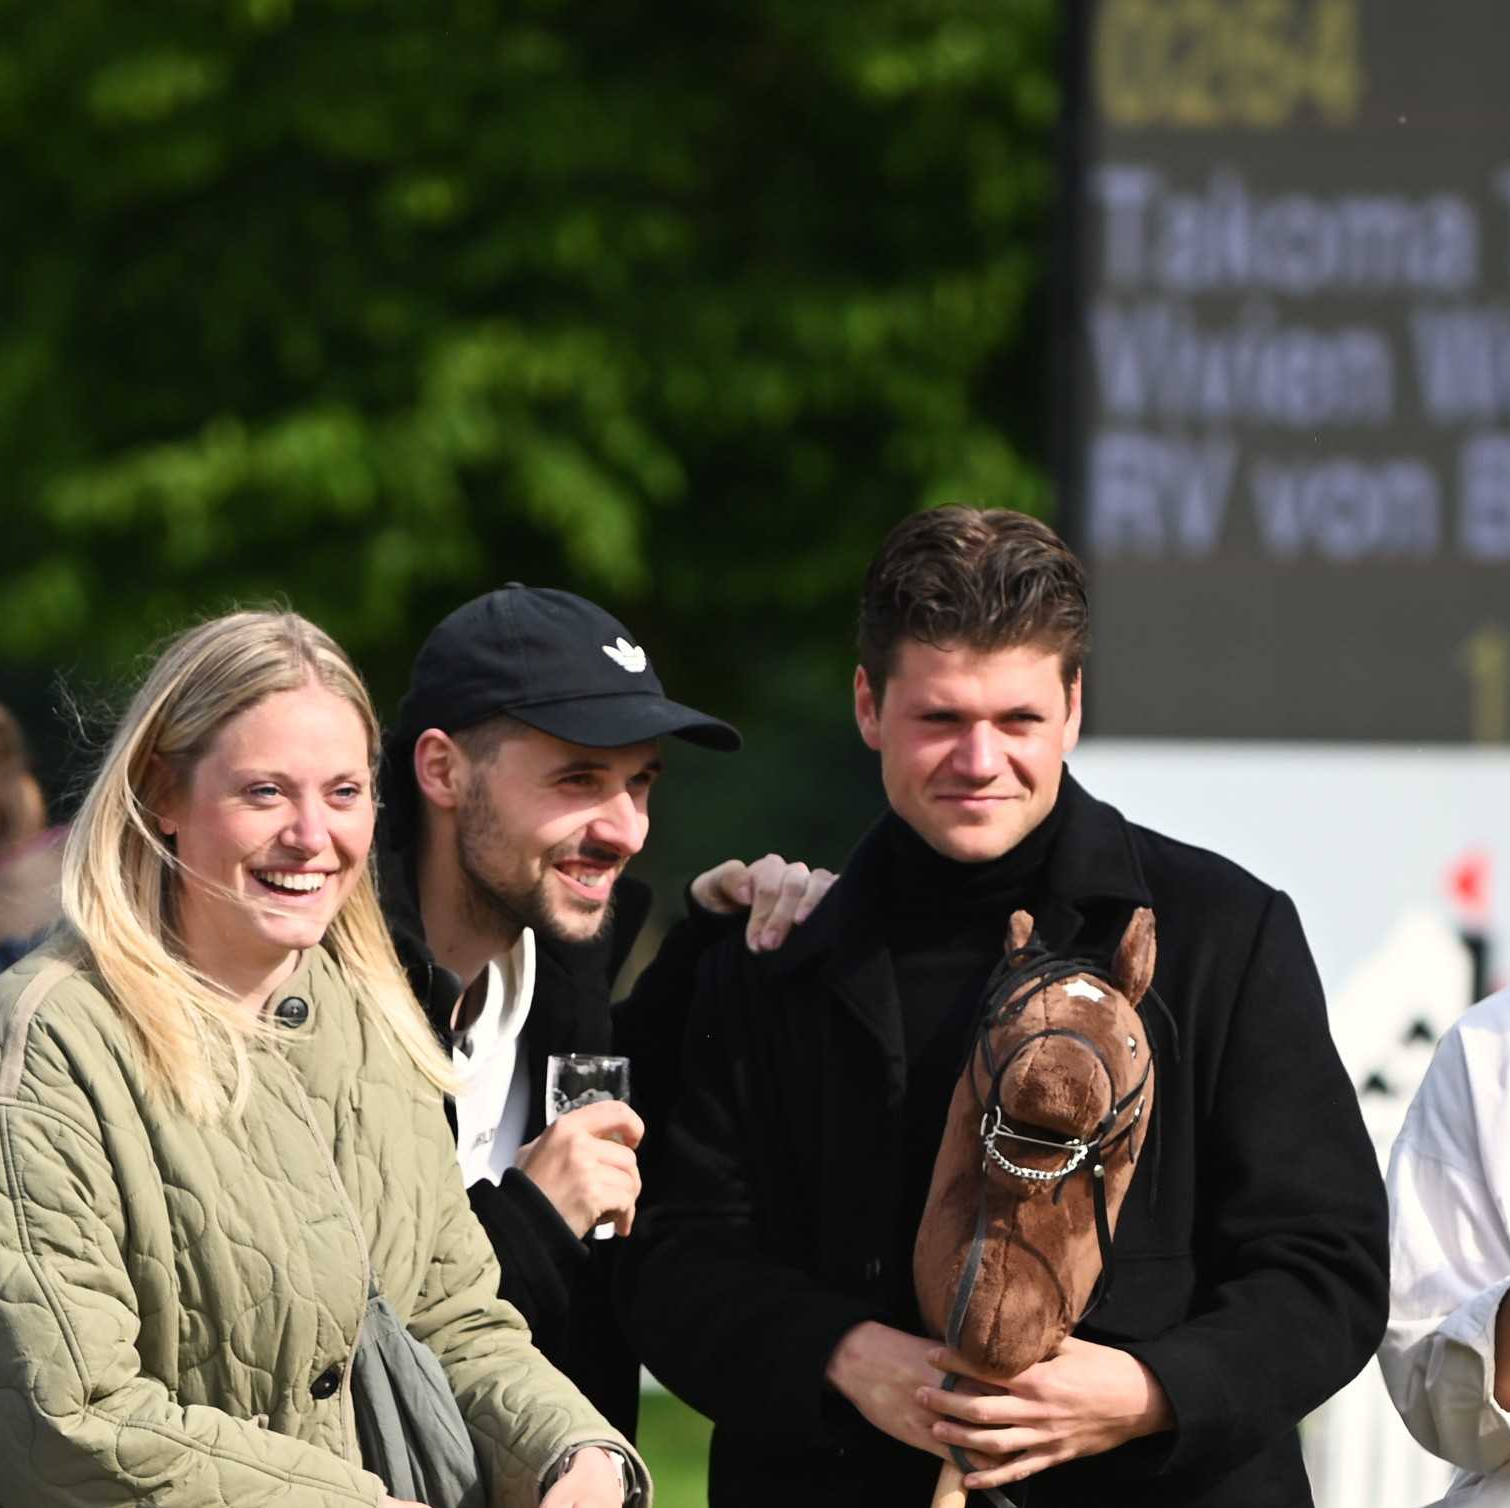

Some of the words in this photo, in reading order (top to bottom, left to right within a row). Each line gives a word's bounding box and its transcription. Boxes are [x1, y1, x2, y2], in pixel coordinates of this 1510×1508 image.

[1095, 168, 1475, 284] Takoma
[1091, 306, 1389, 422] Vivien
[1088, 434, 1229, 560] RV
[1255, 460, 1438, 560] von
